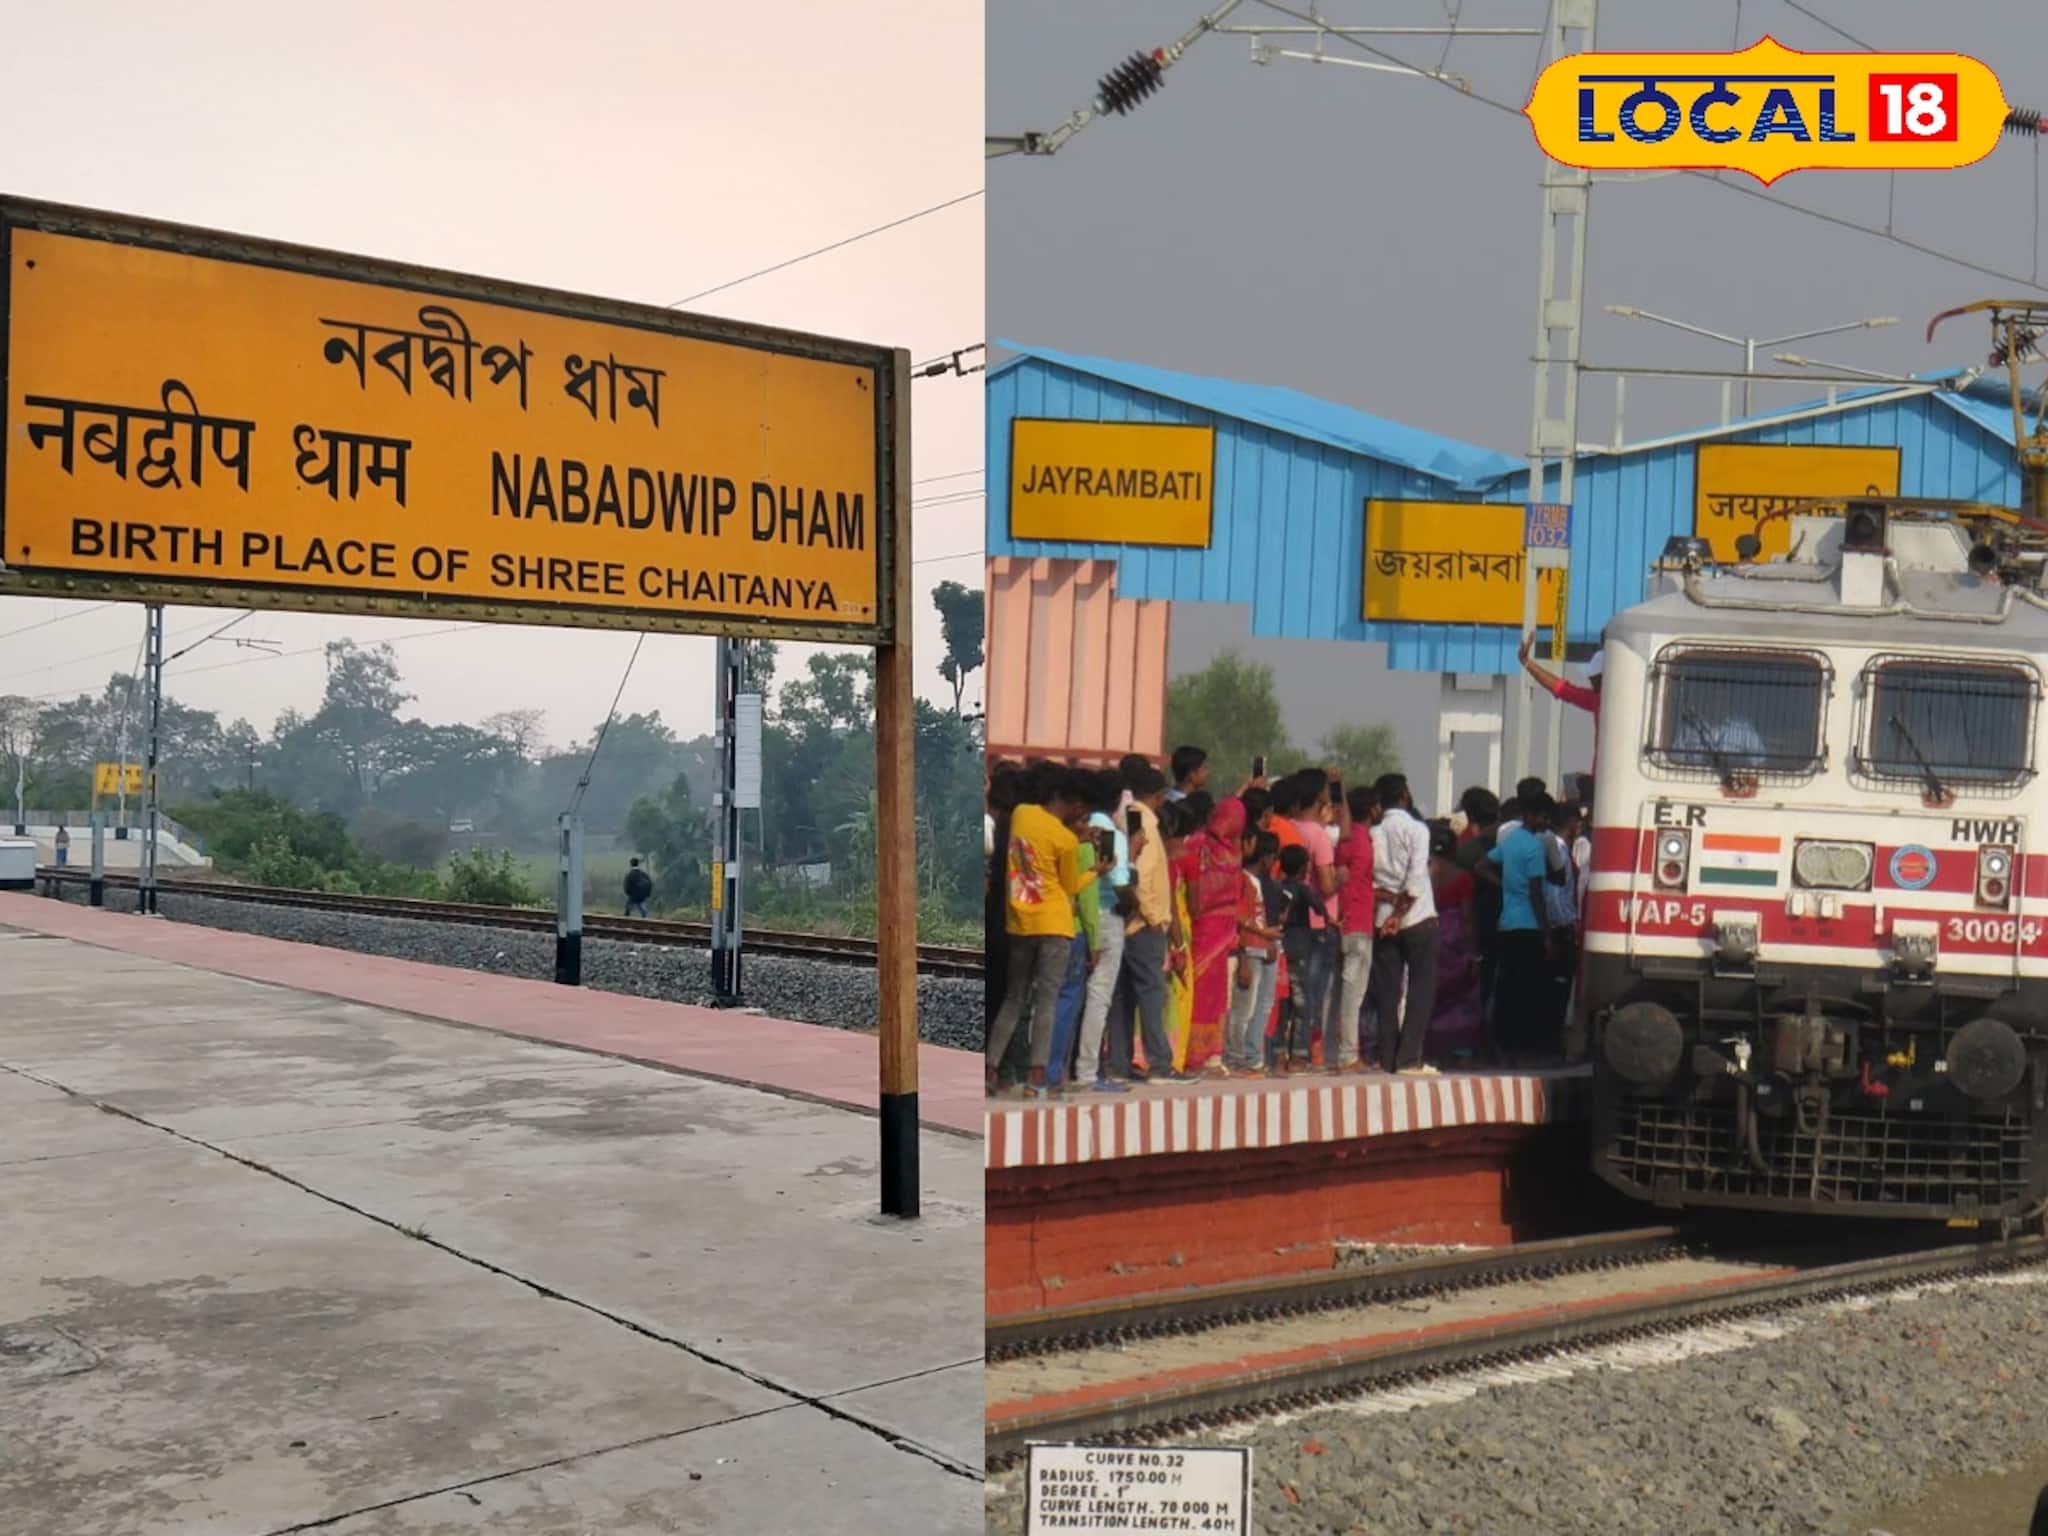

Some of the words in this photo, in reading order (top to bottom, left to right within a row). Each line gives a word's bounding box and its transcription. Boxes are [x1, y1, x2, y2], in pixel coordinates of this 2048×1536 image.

[319, 304, 534, 412] নবদ্বীপ
[564, 352, 667, 429] ধাম
[24, 378, 256, 494] नबद्वीप
[292, 423, 412, 509] धाम
[1021, 464, 1202, 502] JAYRAMBATI
[491, 450, 737, 537] NABADWIP
[751, 481, 865, 551] DHAM
[70, 517, 223, 566] BIRTH
[241, 531, 396, 579] PLACE
[411, 546, 470, 583] OF
[490, 553, 625, 595] SHREE
[638, 566, 838, 612] CHAITANYA
[1618, 898, 1707, 927] WAP-5
[1947, 917, 2043, 945] 30084
[1085, 1452, 1135, 1466] CURVE
[1040, 1499, 1082, 1513] CURVE
[1216, 1502, 1229, 1516] M
[1040, 1514, 1130, 1529] TRANSITION
